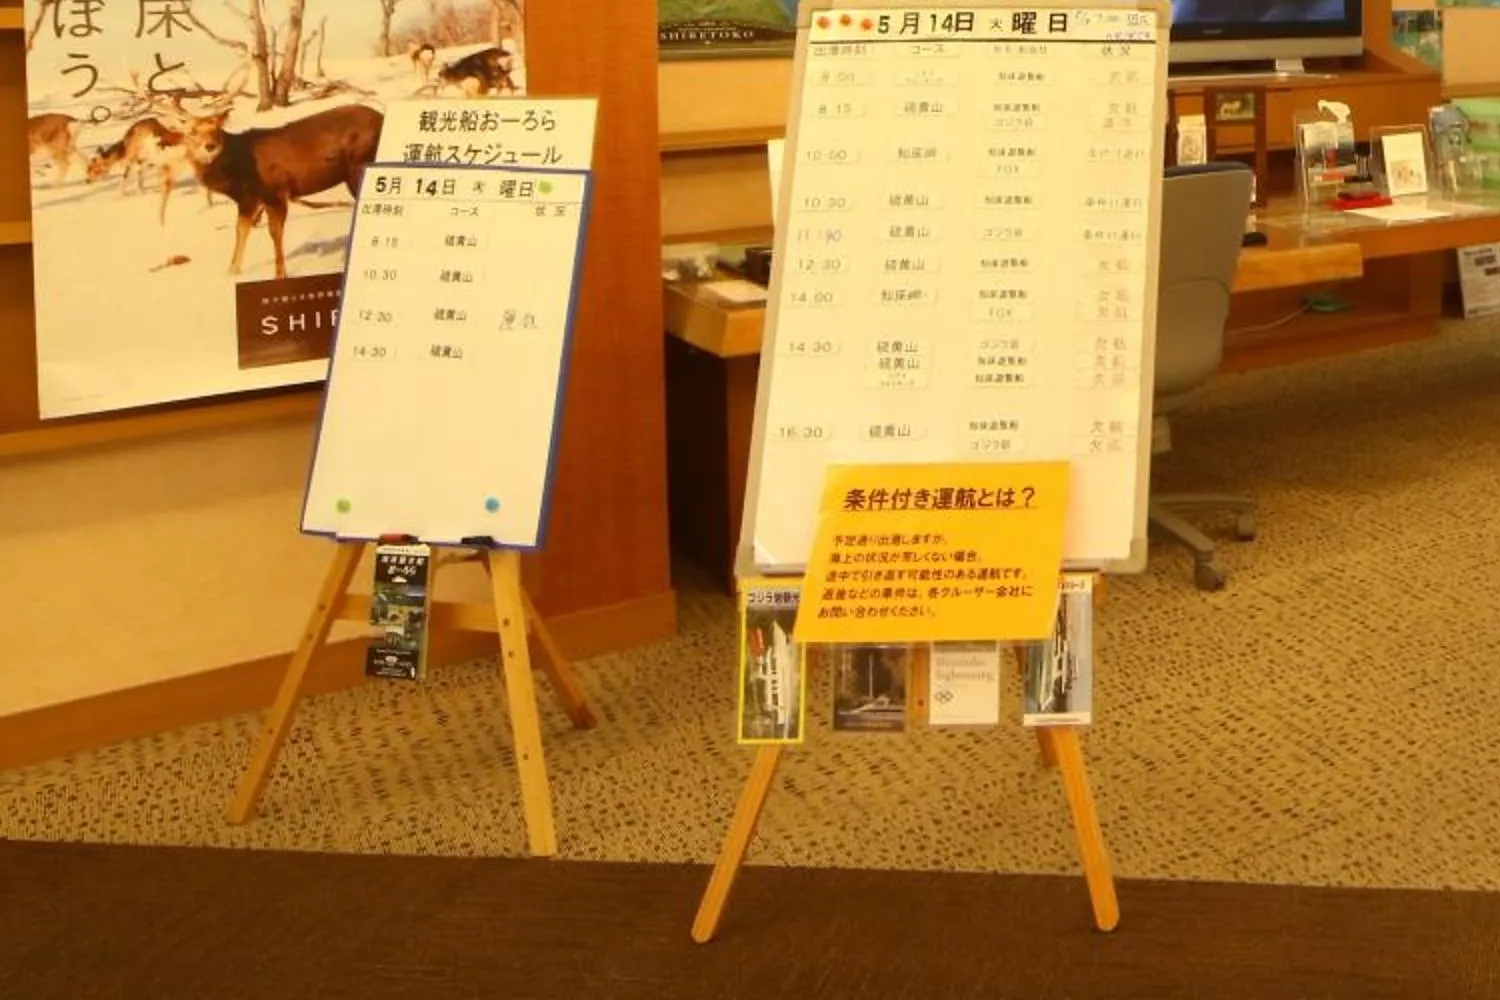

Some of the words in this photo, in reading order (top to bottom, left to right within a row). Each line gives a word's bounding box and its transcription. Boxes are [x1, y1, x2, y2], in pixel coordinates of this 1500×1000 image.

[911, 44, 945, 55] コース
[419, 110, 556, 133] 観光船おーろら
[403, 143, 562, 165] 運航スケジュール
[450, 206, 479, 217] コース
[843, 486, 1036, 512] 条件付き運航とは？
